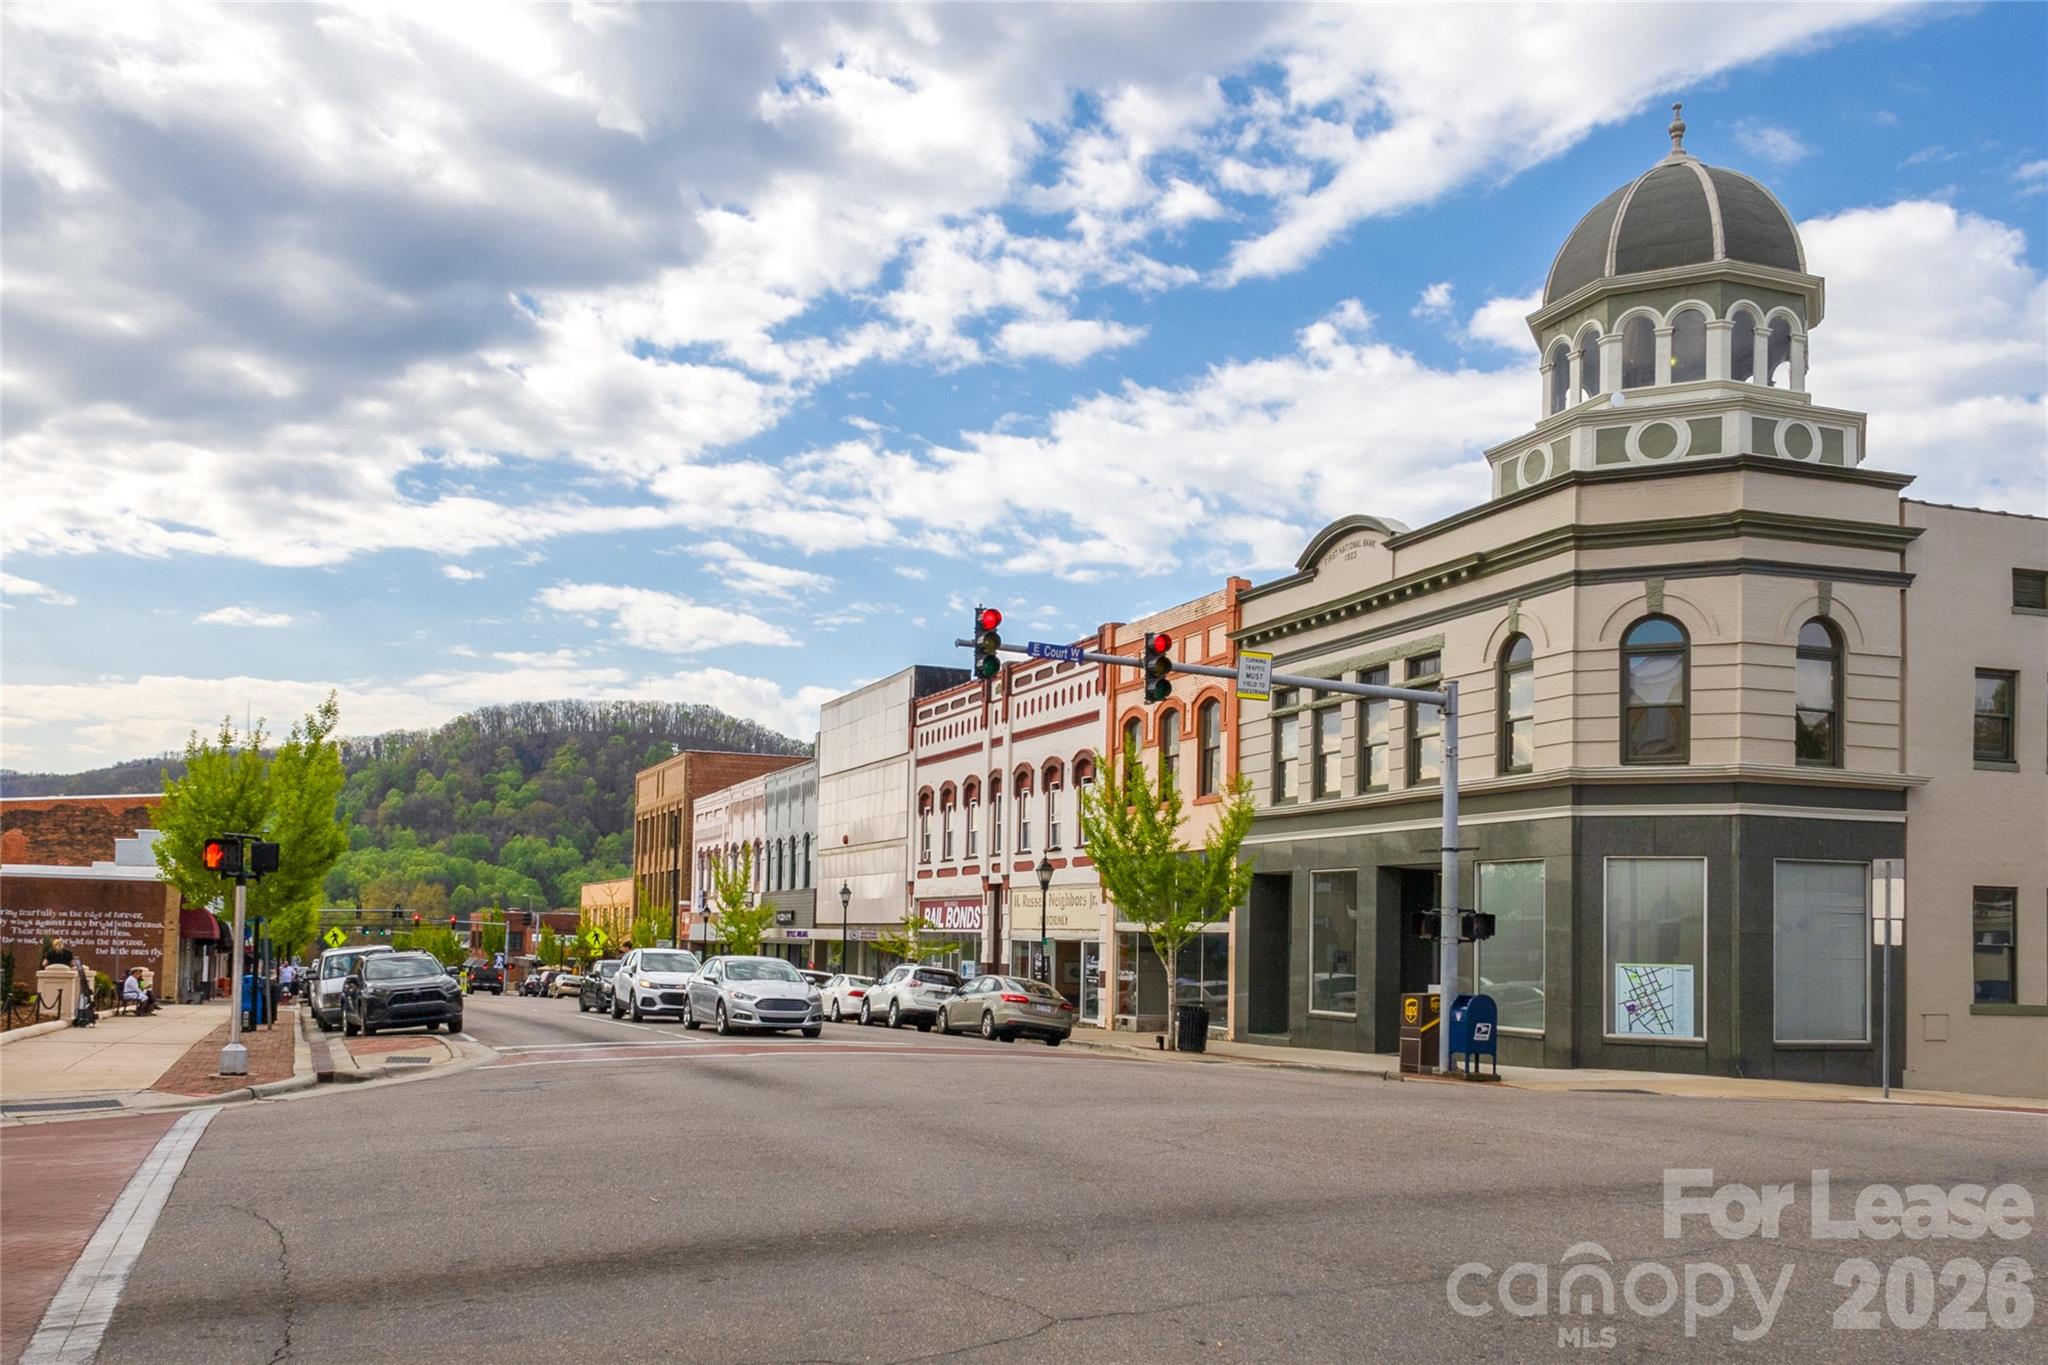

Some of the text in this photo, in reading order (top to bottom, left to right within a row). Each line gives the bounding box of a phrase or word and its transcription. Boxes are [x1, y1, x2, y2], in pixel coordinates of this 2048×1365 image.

[1362, 538, 1377, 549] BANK
[1033, 643, 1081, 659] E Court W
[1245, 663, 1266, 672] TRAFFIC
[1245, 672, 1265, 681] MUST
[1243, 680, 1258, 689] YIELD
[1022, 893, 1042, 908] Russe
[1048, 892, 1087, 911] Neighbors
[1089, 891, 1099, 910] Jr.
[19, 908, 57, 919] fearfully
[69, 910, 83, 918] the
[84, 911, 103, 920] edge
[945, 905, 981, 929] BONDS
[10, 919, 33, 928] wings
[35, 919, 65, 928] against
[74, 919, 88, 929] sky
[89, 920, 114, 929] bright
[11, 926, 35, 935] Their
[36, 927, 69, 936] feathers
[97, 938, 110, 946] the
[95, 947, 109, 955] the
[130, 948, 149, 956] ones
